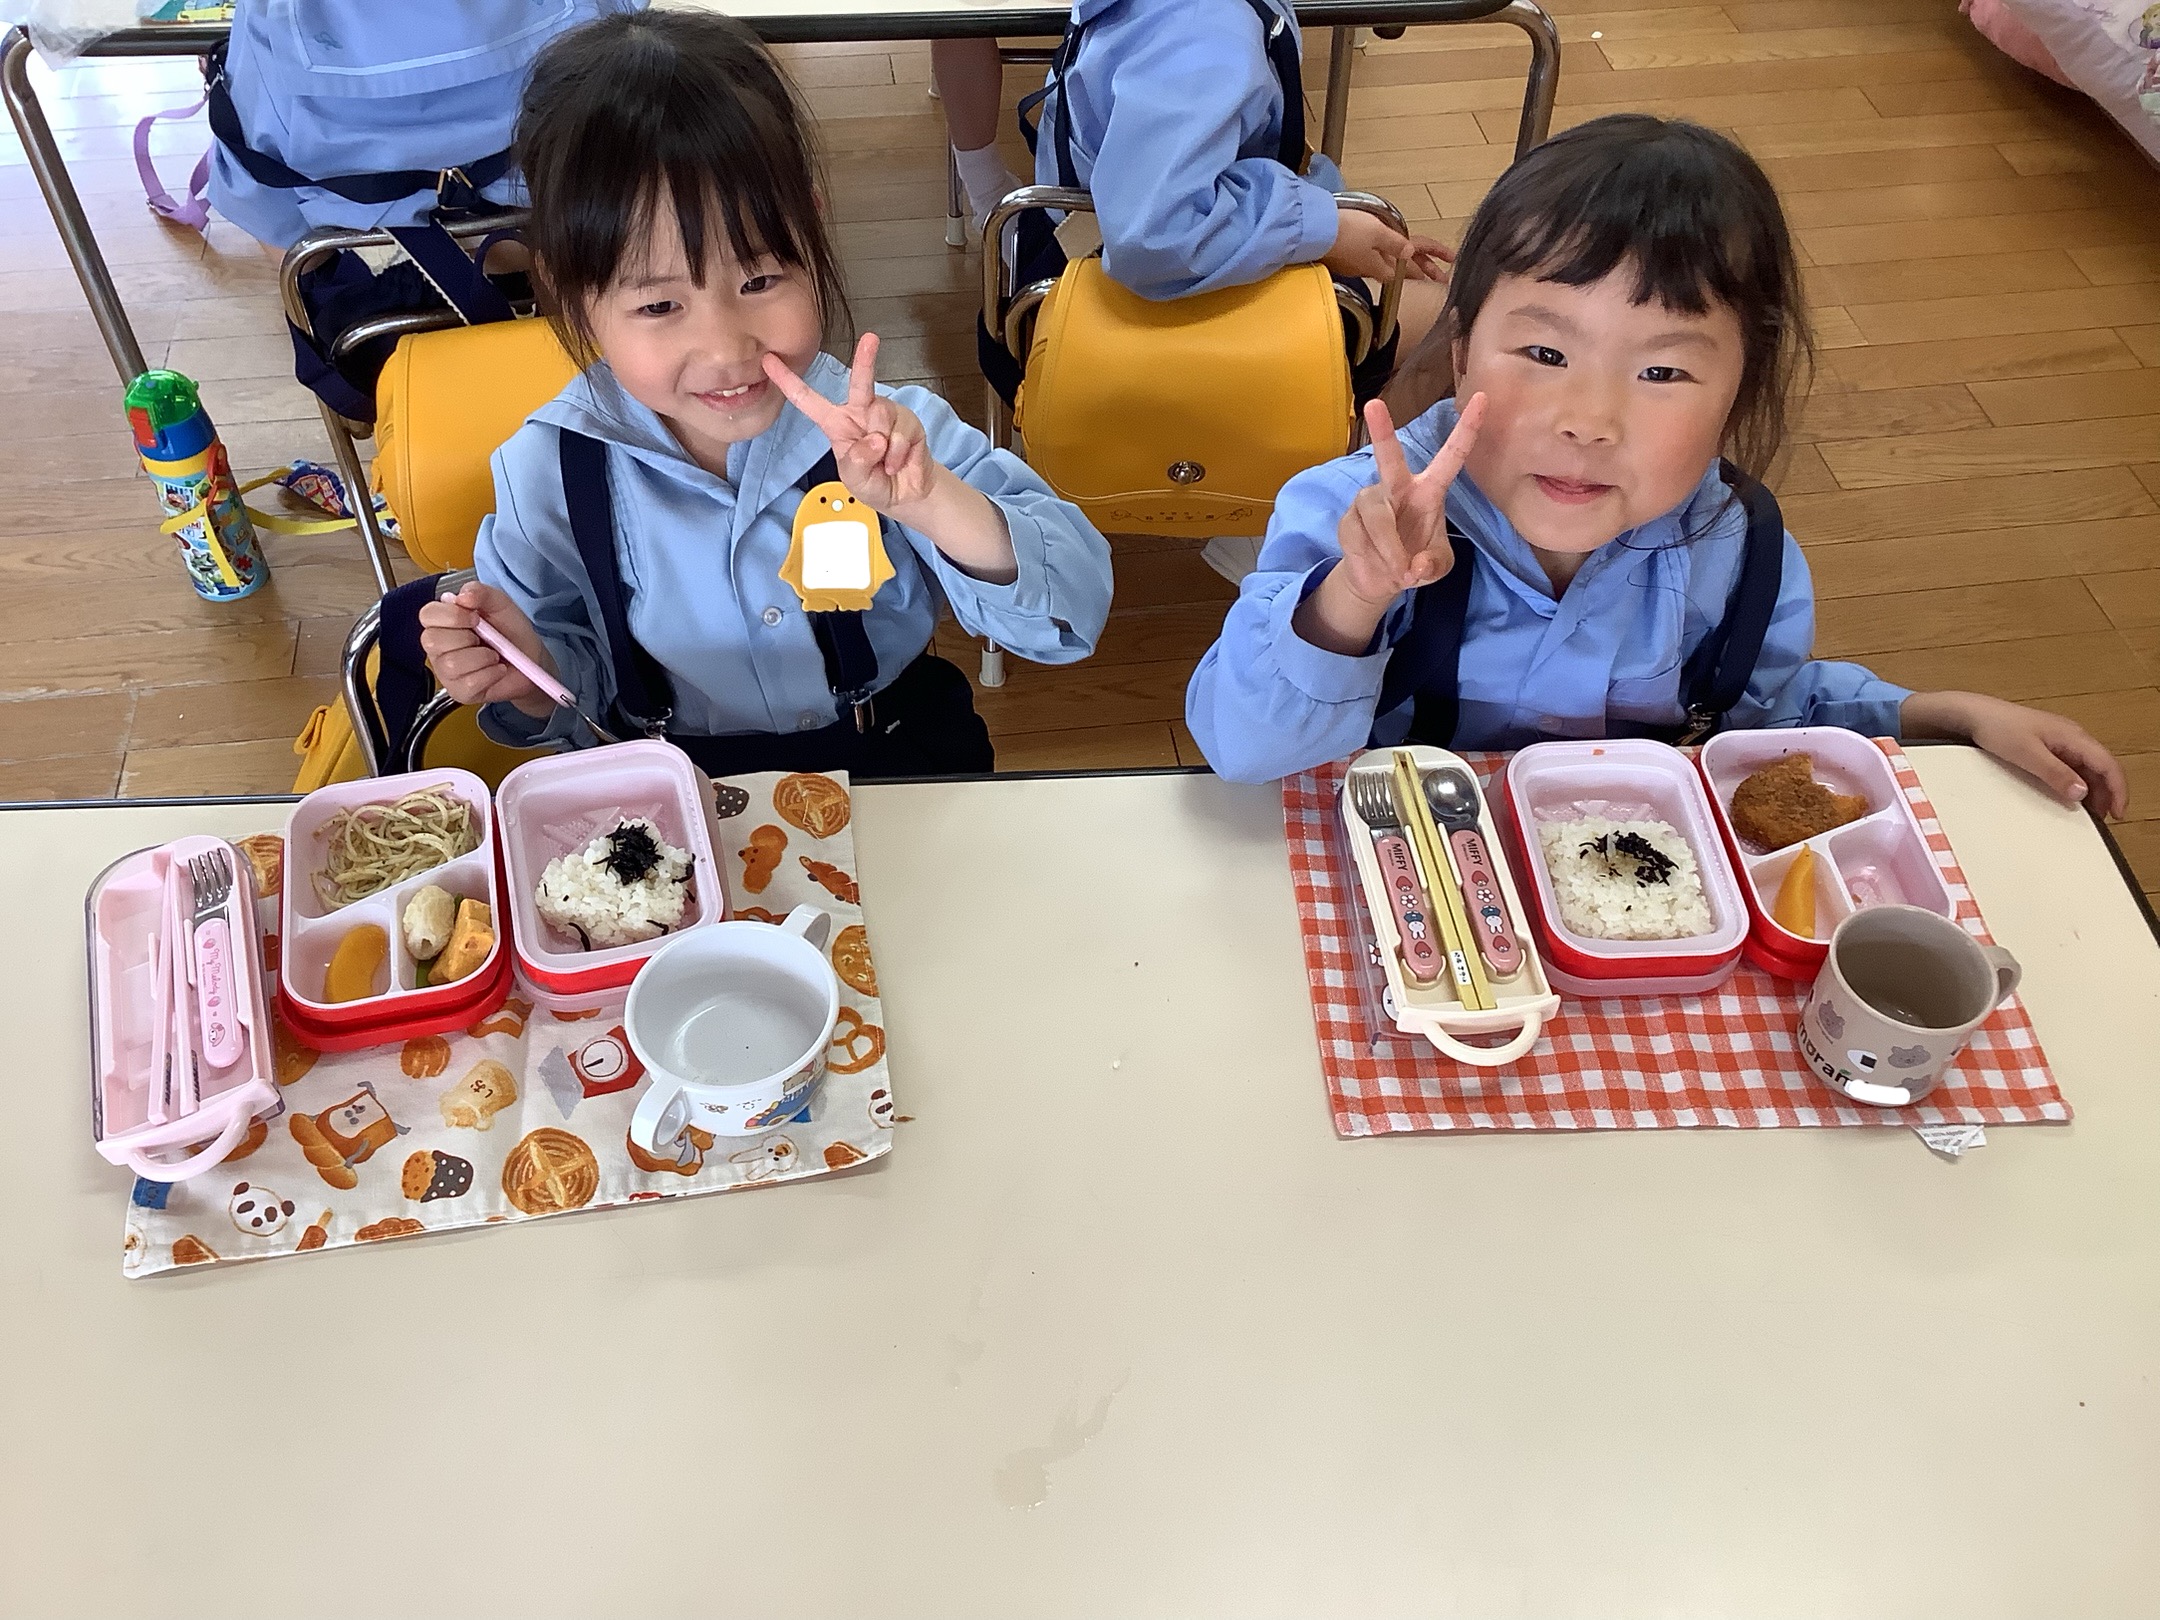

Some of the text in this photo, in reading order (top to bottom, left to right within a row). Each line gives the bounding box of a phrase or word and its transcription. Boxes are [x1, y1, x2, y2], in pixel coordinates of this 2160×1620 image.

[1392, 843, 1408, 871] MIFFY
[1466, 838, 1483, 866] MIFFY
[208, 963, 221, 995] Melody
[470, 1079, 493, 1098] しお
